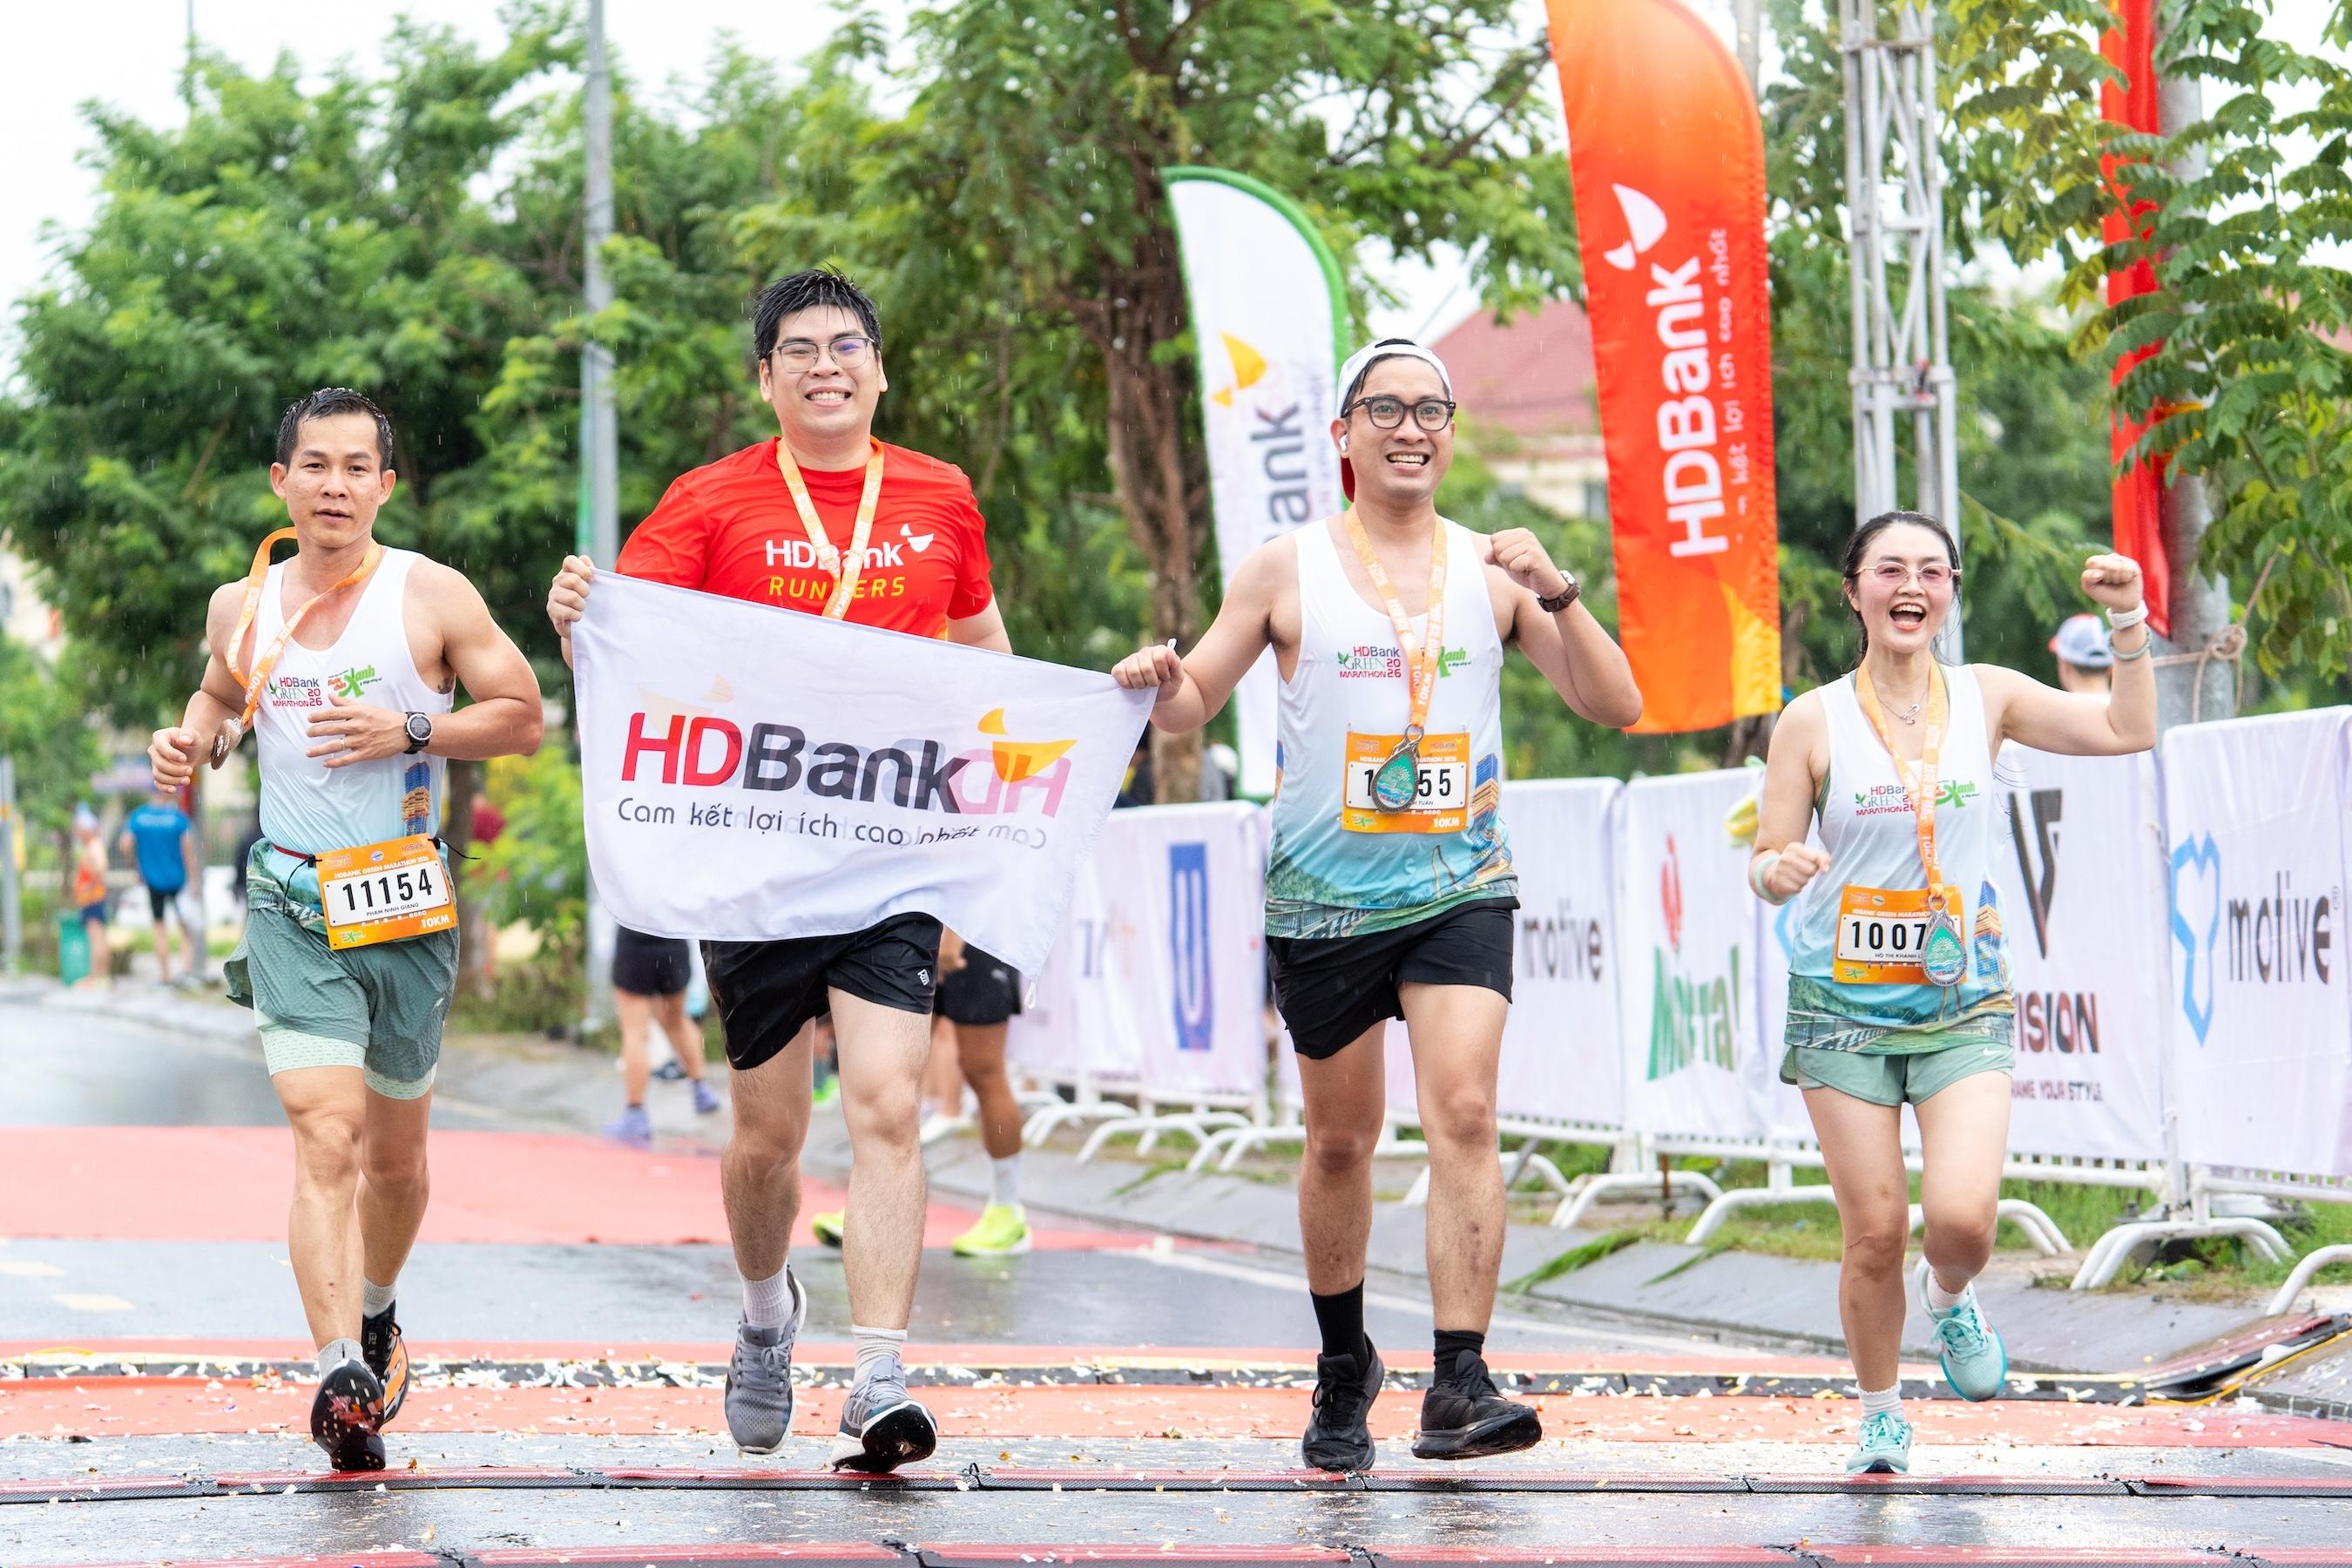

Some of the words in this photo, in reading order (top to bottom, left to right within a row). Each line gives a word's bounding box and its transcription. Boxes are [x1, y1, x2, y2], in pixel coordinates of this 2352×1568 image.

[1646, 255, 1730, 558] HDBank
[1248, 403, 1312, 528] ank
[767, 575, 907, 601] RUNERS
[1353, 645, 1401, 658] HDBank
[1339, 669, 1387, 679] MARATHON
[1387, 668, 1402, 679] 26
[1344, 657, 1387, 671] GREEN
[1386, 658, 1402, 668] 20
[279, 677, 320, 688] HDBank
[1417, 672, 1434, 706] 10KM
[274, 686, 308, 700] GREEN
[308, 688, 321, 698] 20
[309, 697, 323, 706] 26
[621, 710, 972, 815] HDBank
[1364, 768, 1451, 797] 155
[1869, 784, 1906, 796] HDBa
[1855, 806, 1903, 816] MARATHON
[1861, 794, 1903, 808] GREEN
[1902, 794, 1909, 803] 2
[618, 796, 676, 825] Cam
[689, 801, 733, 828] kết
[747, 805, 783, 835] lợi
[798, 811, 838, 839] ích
[1433, 817, 1460, 828] 10KM
[342, 868, 433, 911] 11154
[421, 914, 450, 929] 10KM
[2228, 870, 2331, 986] motive
[1852, 921, 1927, 950] 1007
[2015, 990, 2099, 1054] ISION
